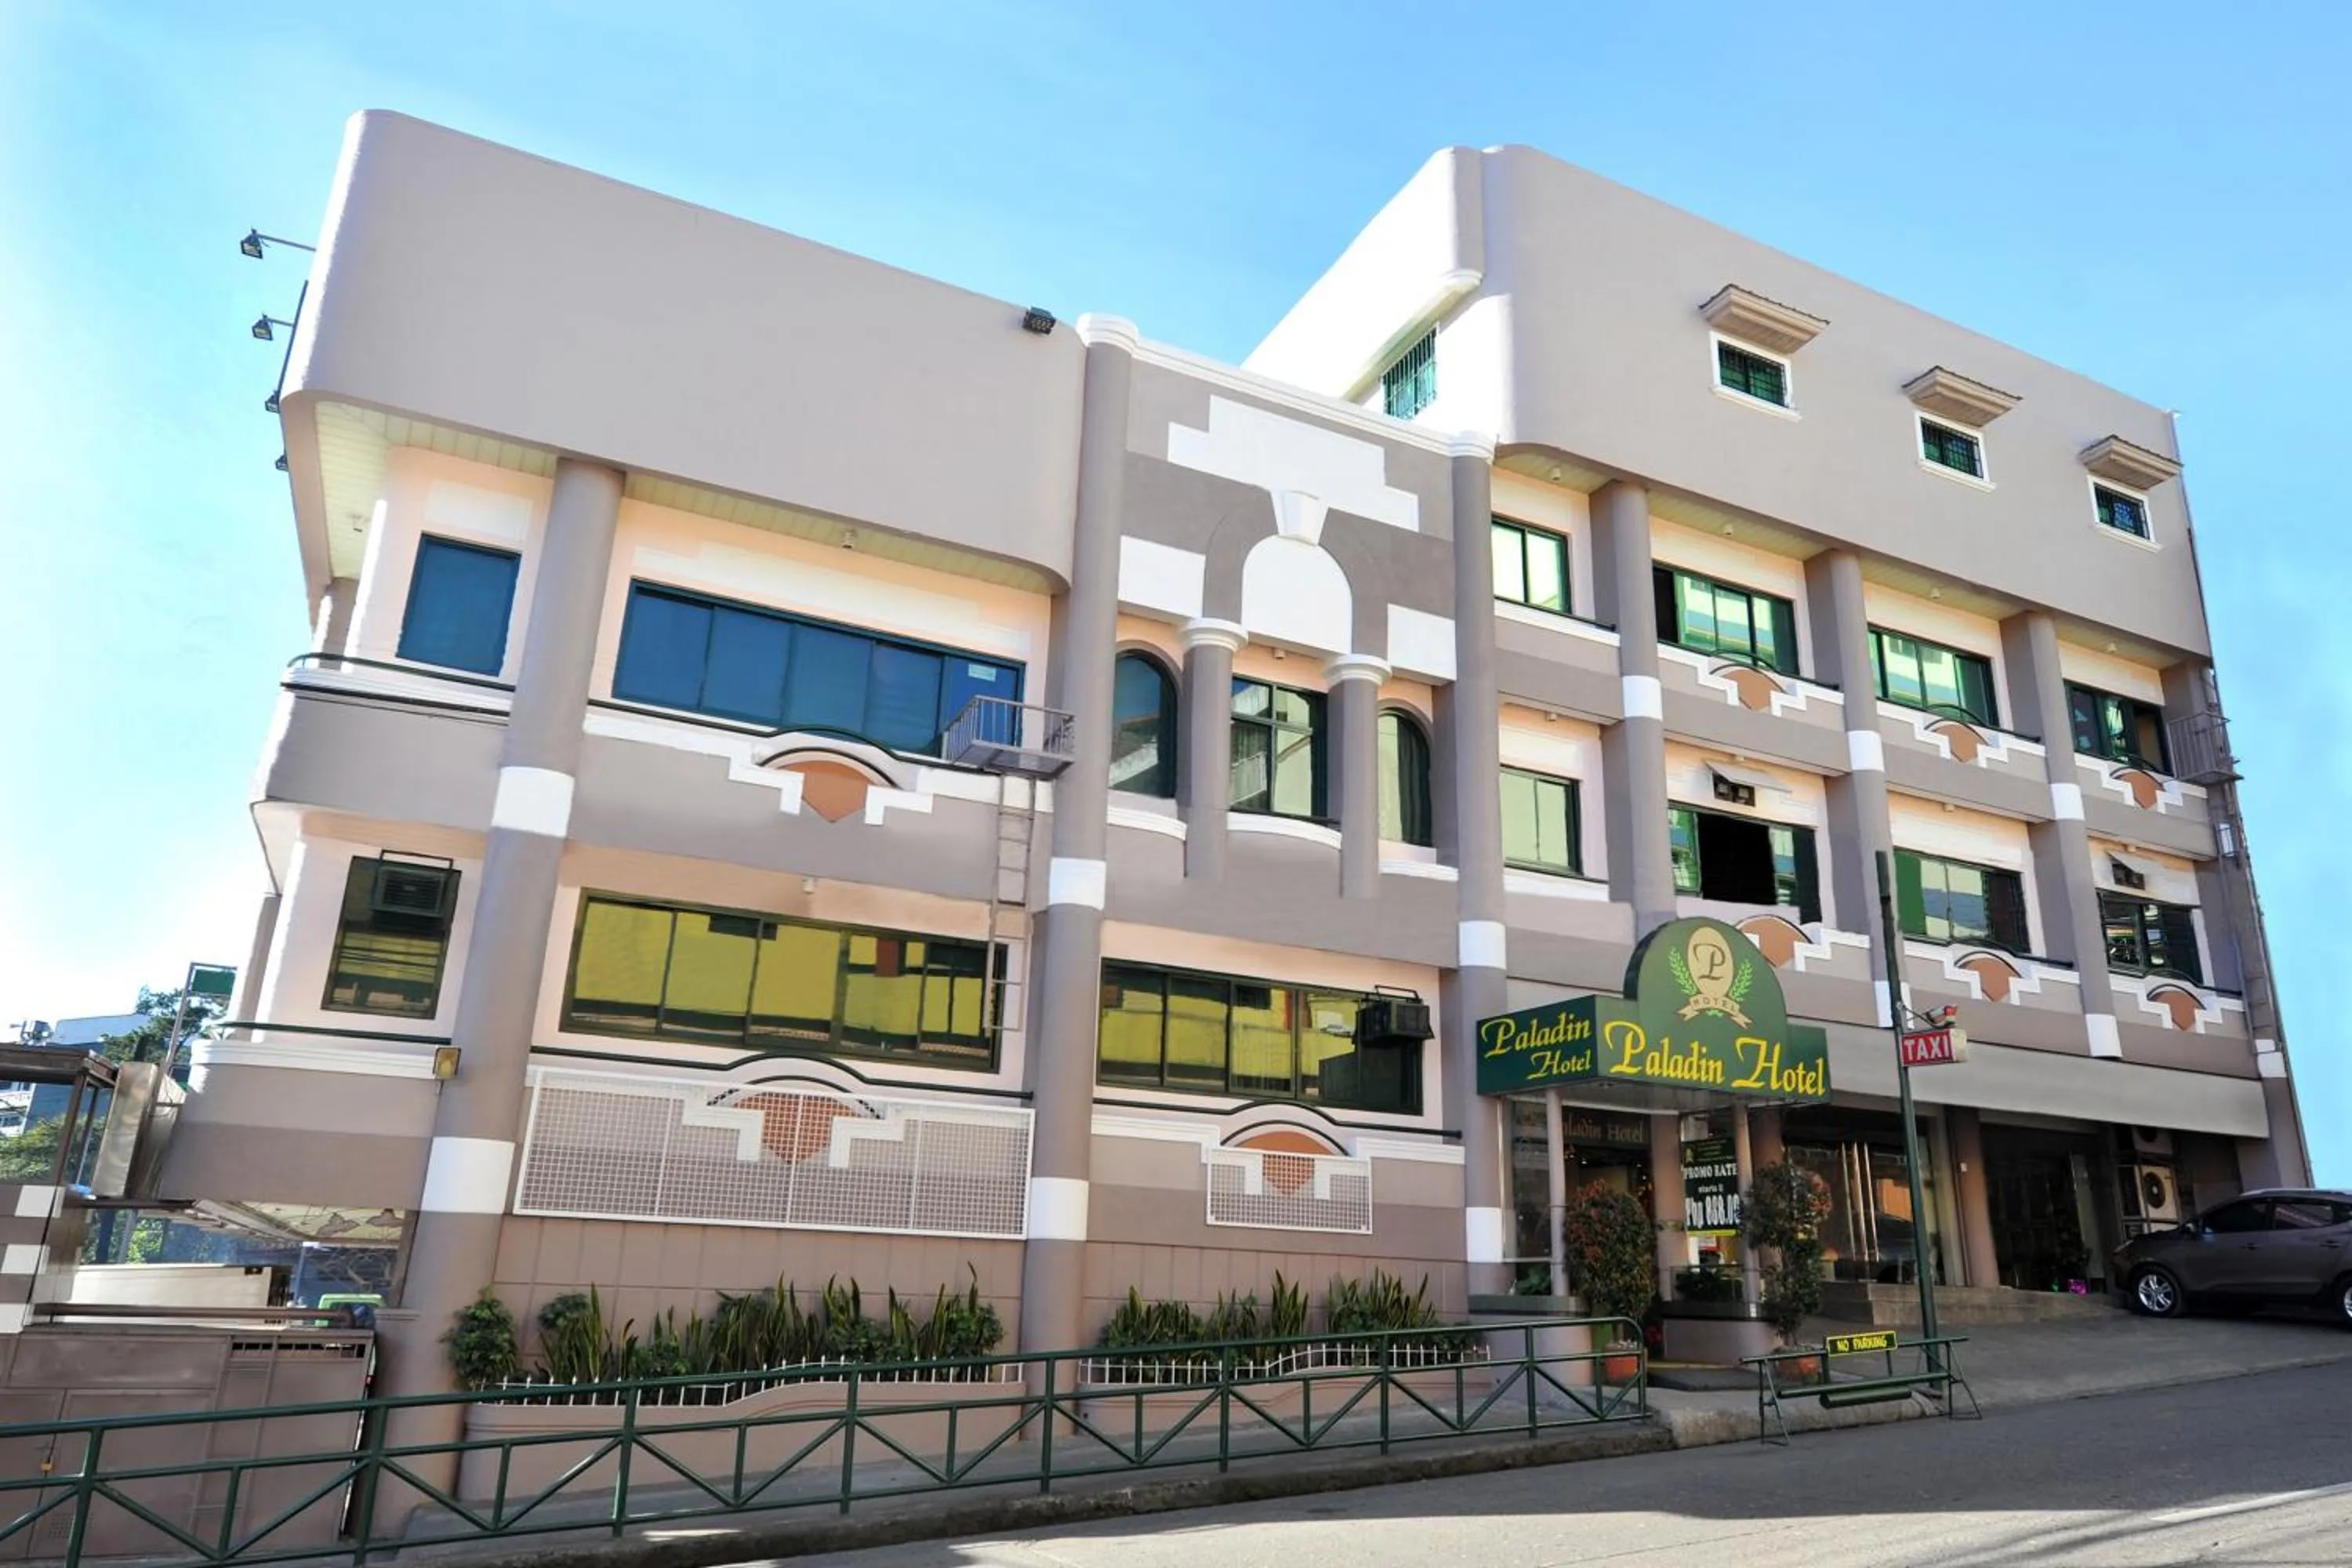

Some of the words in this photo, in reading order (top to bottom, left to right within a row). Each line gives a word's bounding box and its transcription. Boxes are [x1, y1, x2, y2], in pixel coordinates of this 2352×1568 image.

[1693, 943, 1726, 981] P
[1693, 996, 1737, 1012] HOTEL
[1481, 1011, 1592, 1058] Paladin
[1903, 1034, 1950, 1061] TAXI
[1526, 1048, 1592, 1080] Hotel
[1603, 1020, 1725, 1084] Paladin
[1731, 1036, 1826, 1096] Hotel
[1683, 1164, 1713, 1179] PROMO
[1836, 1338, 1849, 1352] NO
[1853, 1334, 1887, 1350] PARKING
